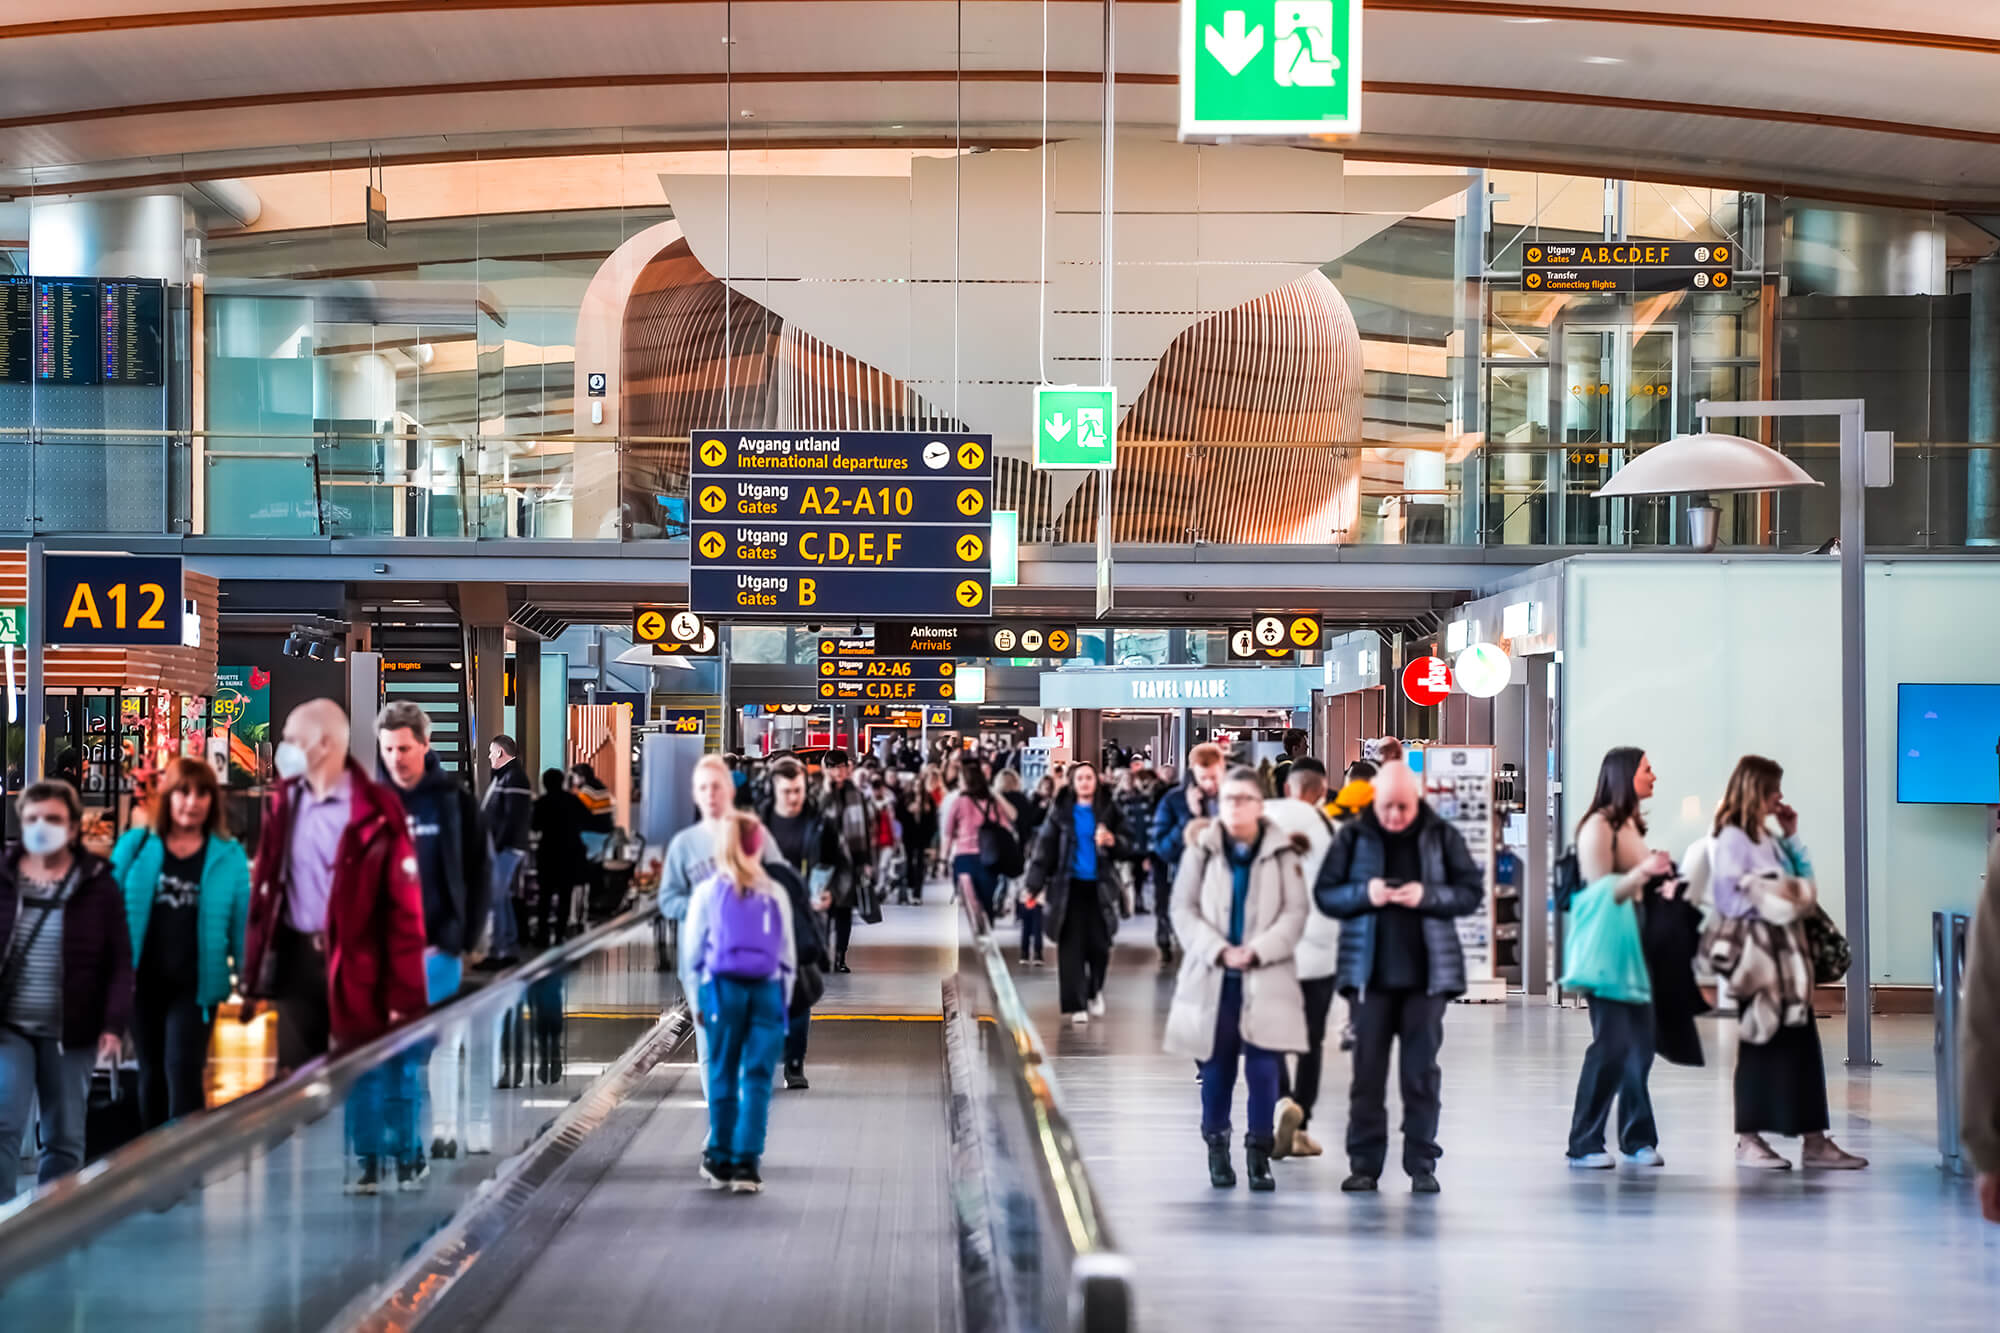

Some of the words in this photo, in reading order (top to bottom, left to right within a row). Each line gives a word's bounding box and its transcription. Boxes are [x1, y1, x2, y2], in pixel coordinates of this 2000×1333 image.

[1547, 246, 1576, 256] Utgang
[1547, 254, 1570, 263] Gates
[1580, 247, 1670, 264] A,B,C,D,E,F
[1546, 271, 1578, 280] Transfer
[1546, 280, 1590, 290] Connecting
[1591, 280, 1617, 290] flights
[737, 436, 791, 454] Avgang
[795, 437, 840, 452] utland
[737, 454, 829, 469] International
[832, 454, 908, 471] departures
[737, 482, 789, 500] Utgang
[737, 499, 778, 514] Gates
[799, 487, 913, 516] A2-A10
[737, 528, 788, 546] Utgang
[737, 545, 777, 560] Gates
[798, 532, 902, 565] C,D,E,F
[737, 574, 788, 592] Utgang
[737, 591, 777, 606] Gates
[798, 577, 817, 606] B
[63, 582, 166, 630] A12
[910, 626, 958, 637] Ankomst
[910, 640, 952, 651] Arrivals
[398, 662, 421, 670] flights
[866, 662, 911, 676] A2-A6
[866, 683, 916, 699] C,D,E,F
[1131, 680, 1179, 698] TRAVEL
[1184, 679, 1228, 698] VALUE
[675, 717, 697, 732] A6
[931, 713, 946, 724] A2
